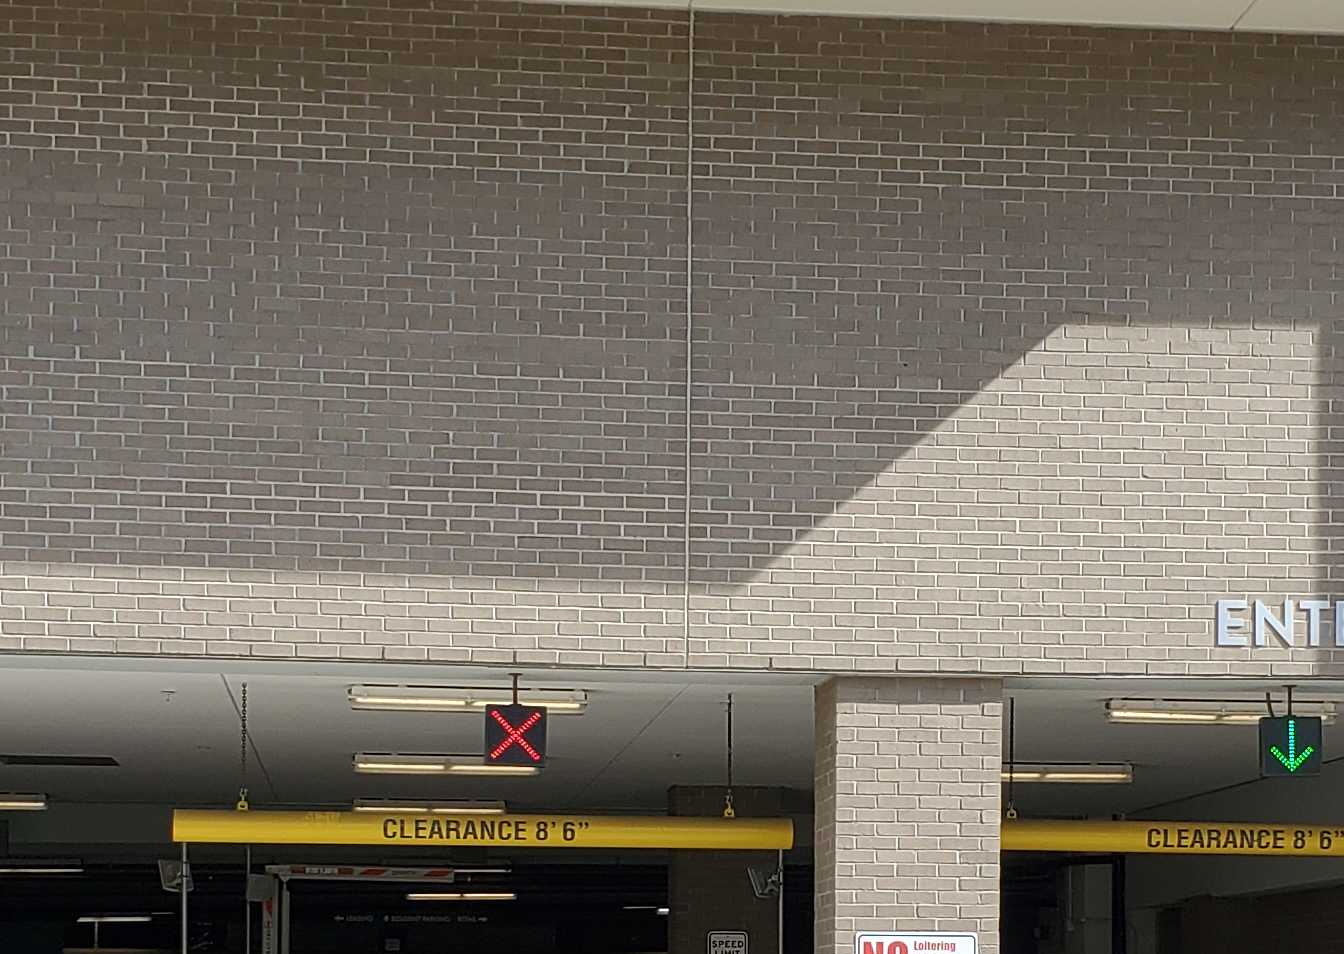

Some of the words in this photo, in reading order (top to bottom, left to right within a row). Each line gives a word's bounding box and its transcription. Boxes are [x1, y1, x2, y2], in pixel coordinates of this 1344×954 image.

[383, 818, 527, 840] CLEARANCE
[1147, 828, 1285, 849] CLEARANCE
[712, 940, 744, 949] SPEED
[913, 941, 956, 951] Loitering
